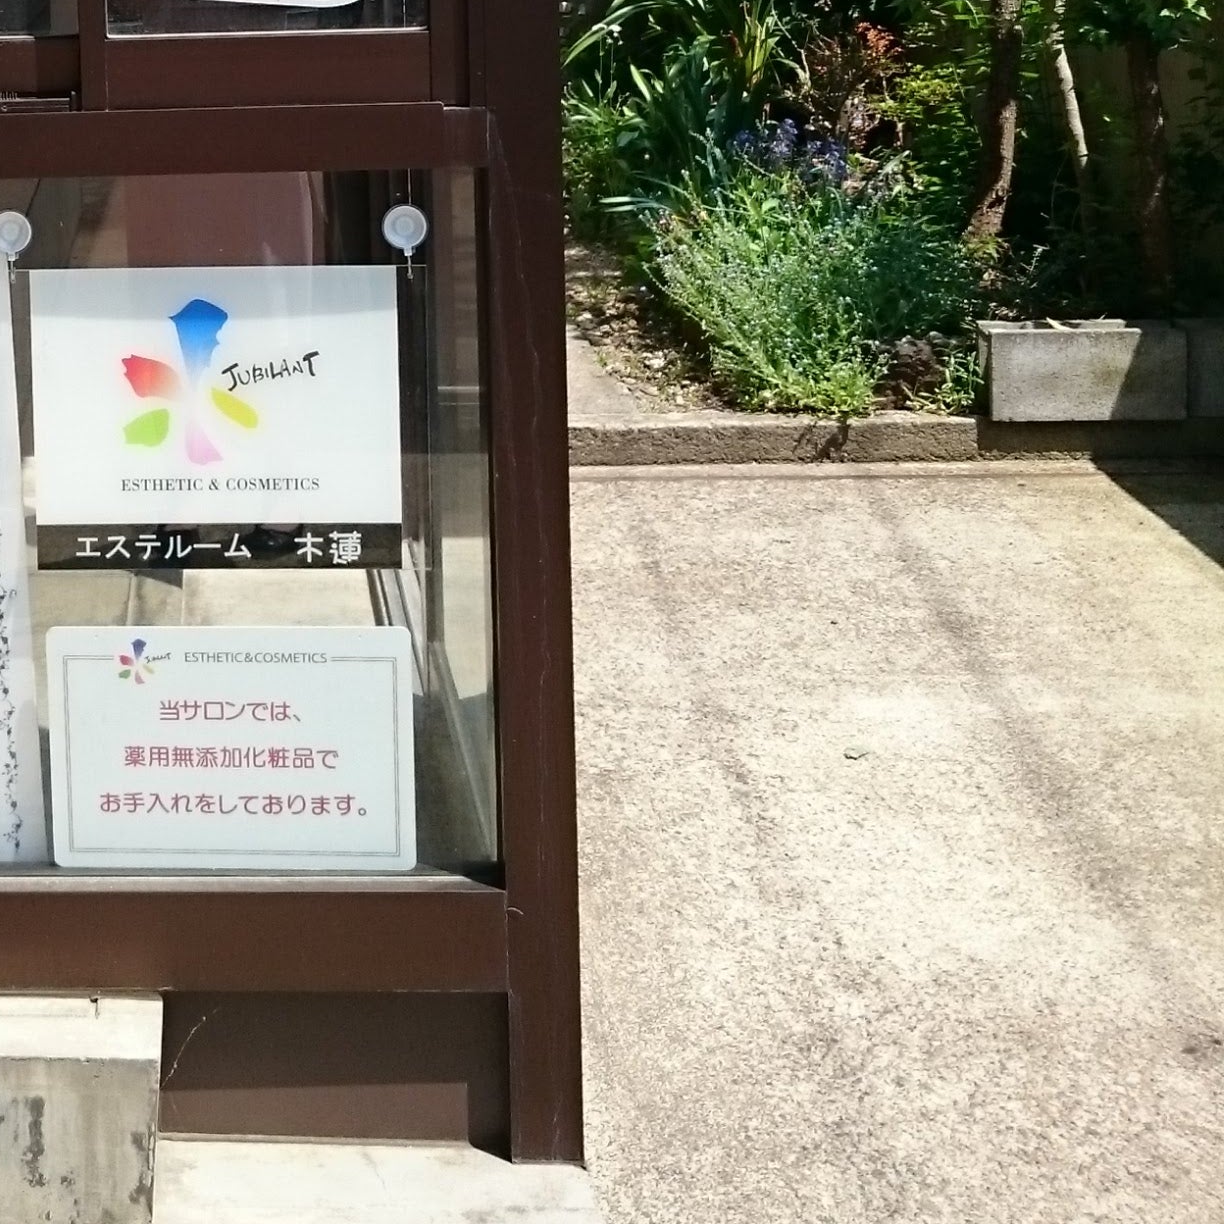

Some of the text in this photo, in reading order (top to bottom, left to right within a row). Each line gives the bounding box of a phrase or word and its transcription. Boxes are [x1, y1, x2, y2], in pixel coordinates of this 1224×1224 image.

[222, 350, 320, 392] JUBILANT
[121, 477, 320, 492] ESTHETIC & COSMETICS
[76, 530, 362, 565] エステルーム 木蓮
[184, 651, 328, 664] ESTHETIC&COSMETICS
[159, 700, 301, 722] 当サロンでは、
[124, 745, 339, 770] 薬用無添加化粧品で
[99, 792, 367, 817] お手入れをしております。
